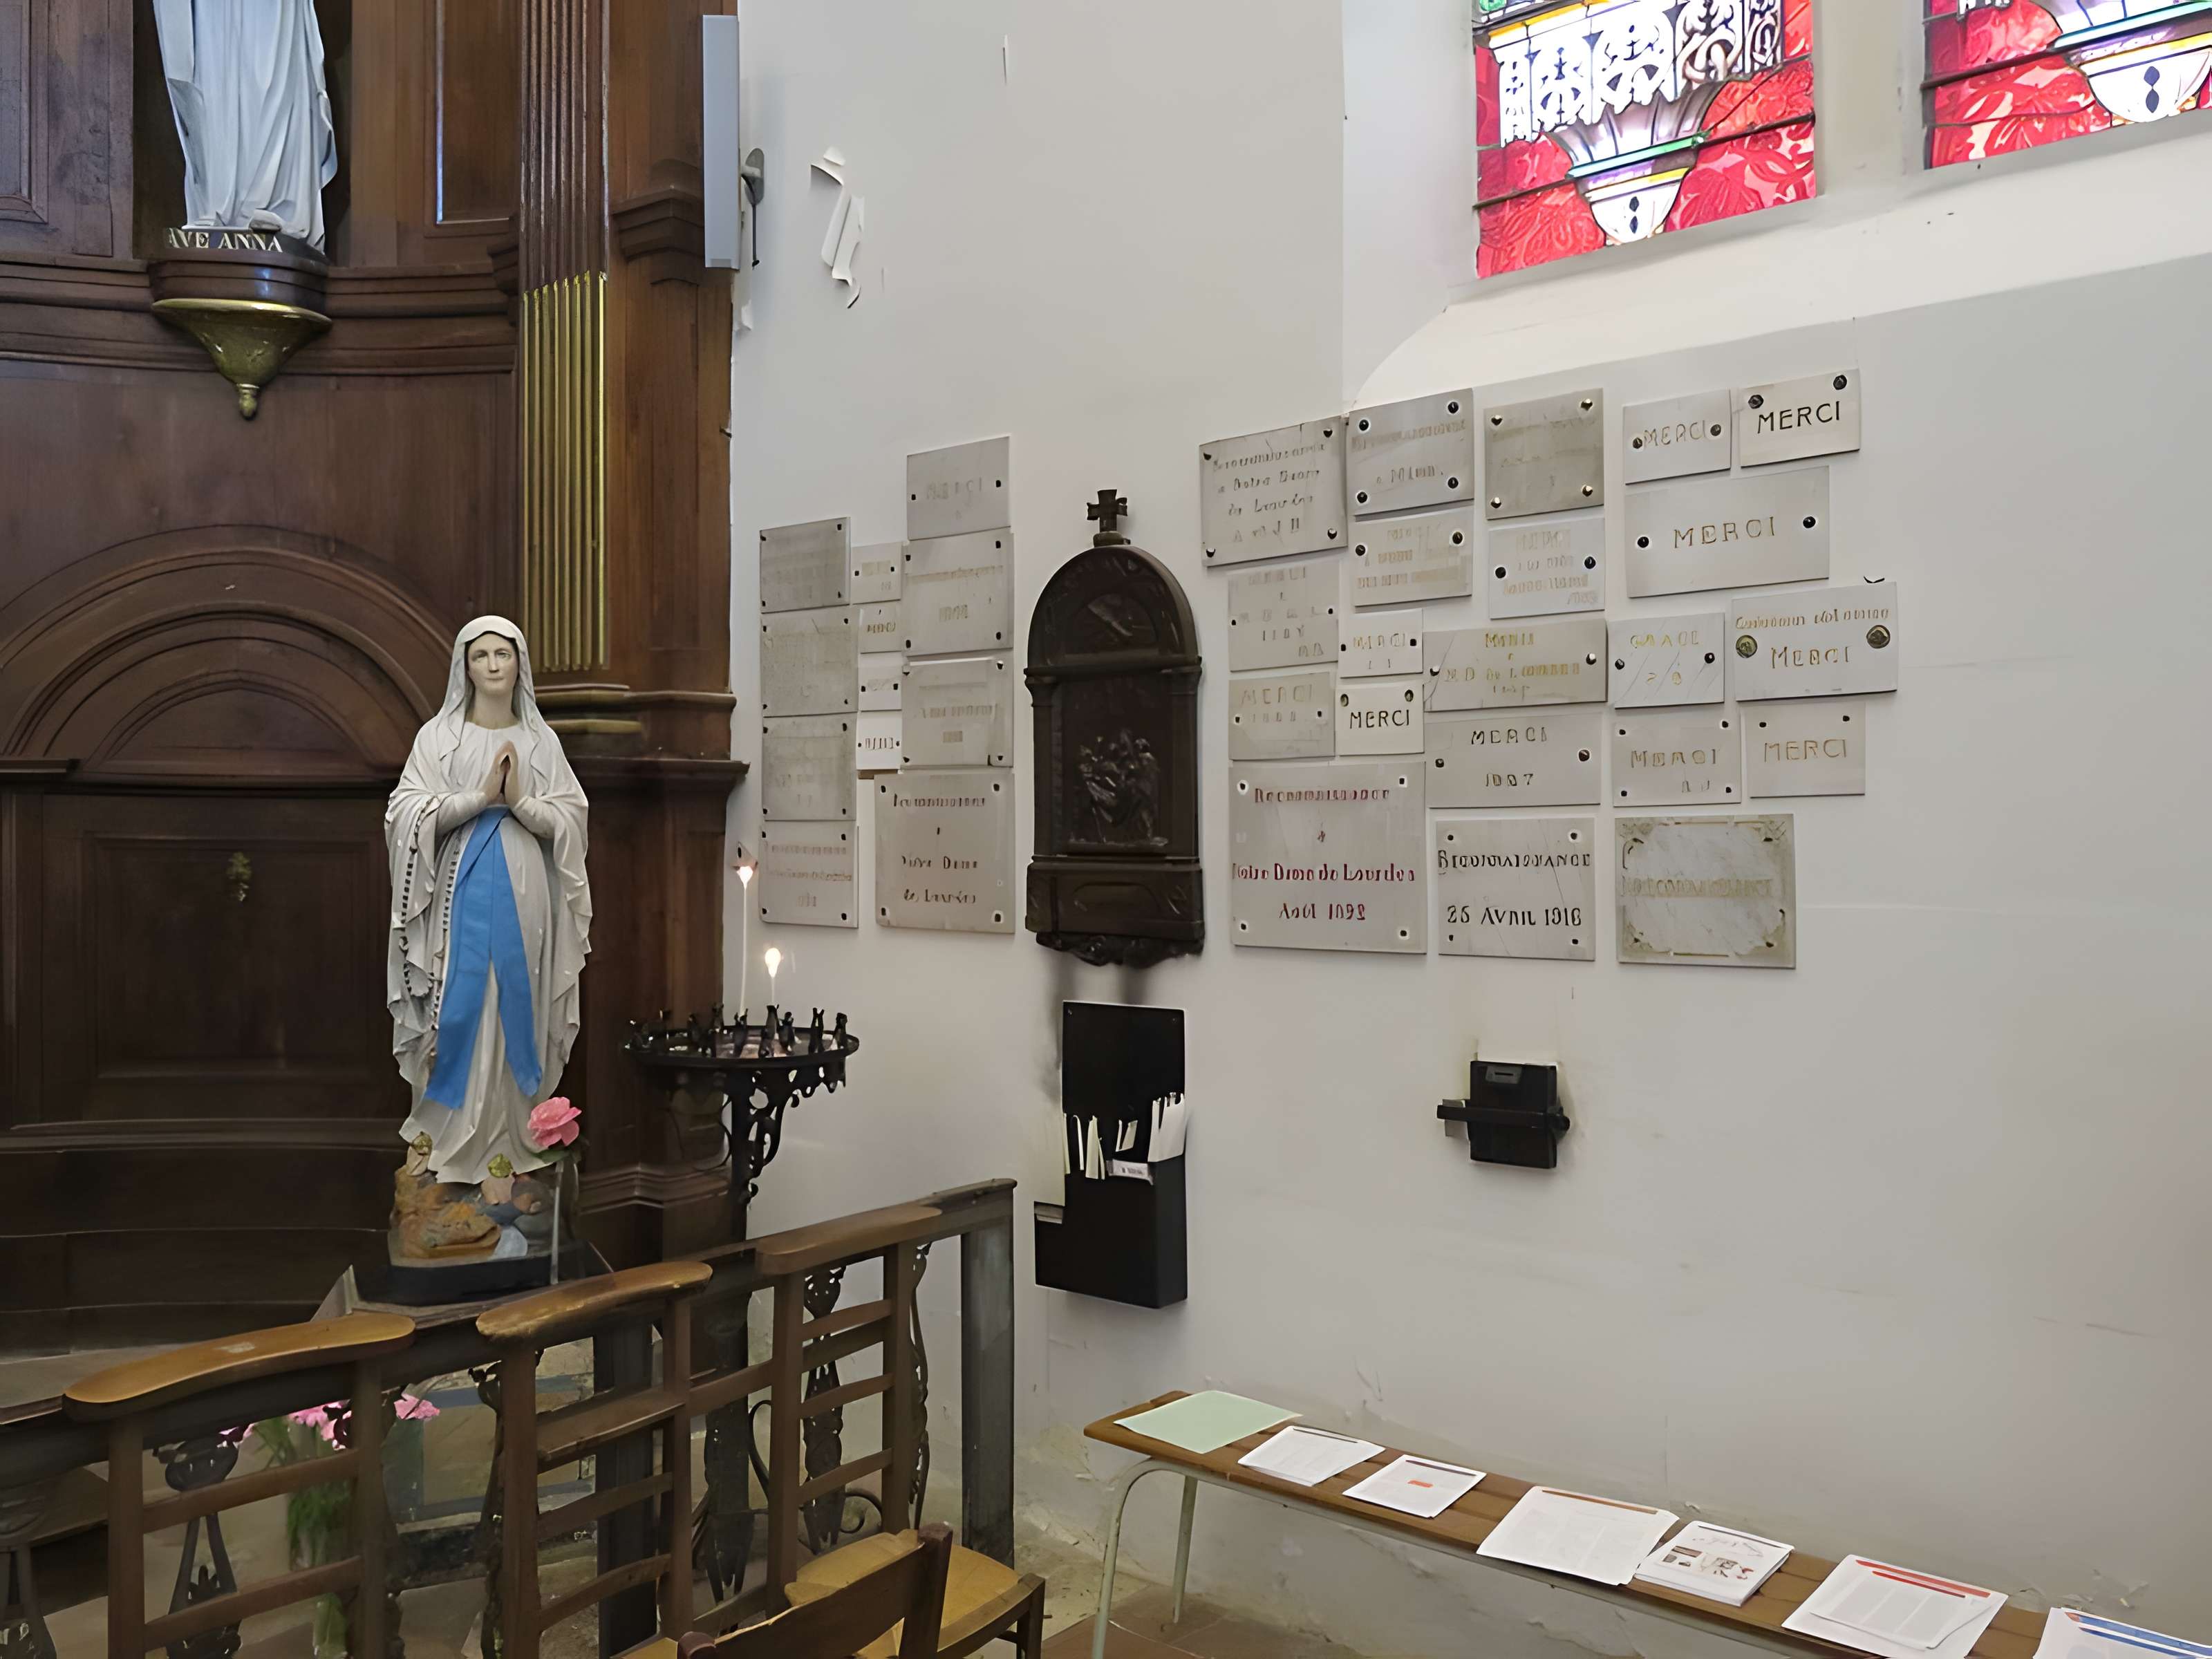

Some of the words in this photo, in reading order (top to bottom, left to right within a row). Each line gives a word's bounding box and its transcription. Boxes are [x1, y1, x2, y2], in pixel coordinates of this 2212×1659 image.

[168, 228, 209, 249] AVE
[218, 232, 283, 253] ANNA
[1757, 400, 1841, 435] MERCI
[1643, 420, 1707, 448] MERCI
[1674, 516, 1777, 549] MERCI
[1349, 709, 1411, 730] MERCI
[1764, 739, 1848, 763] MERCI
